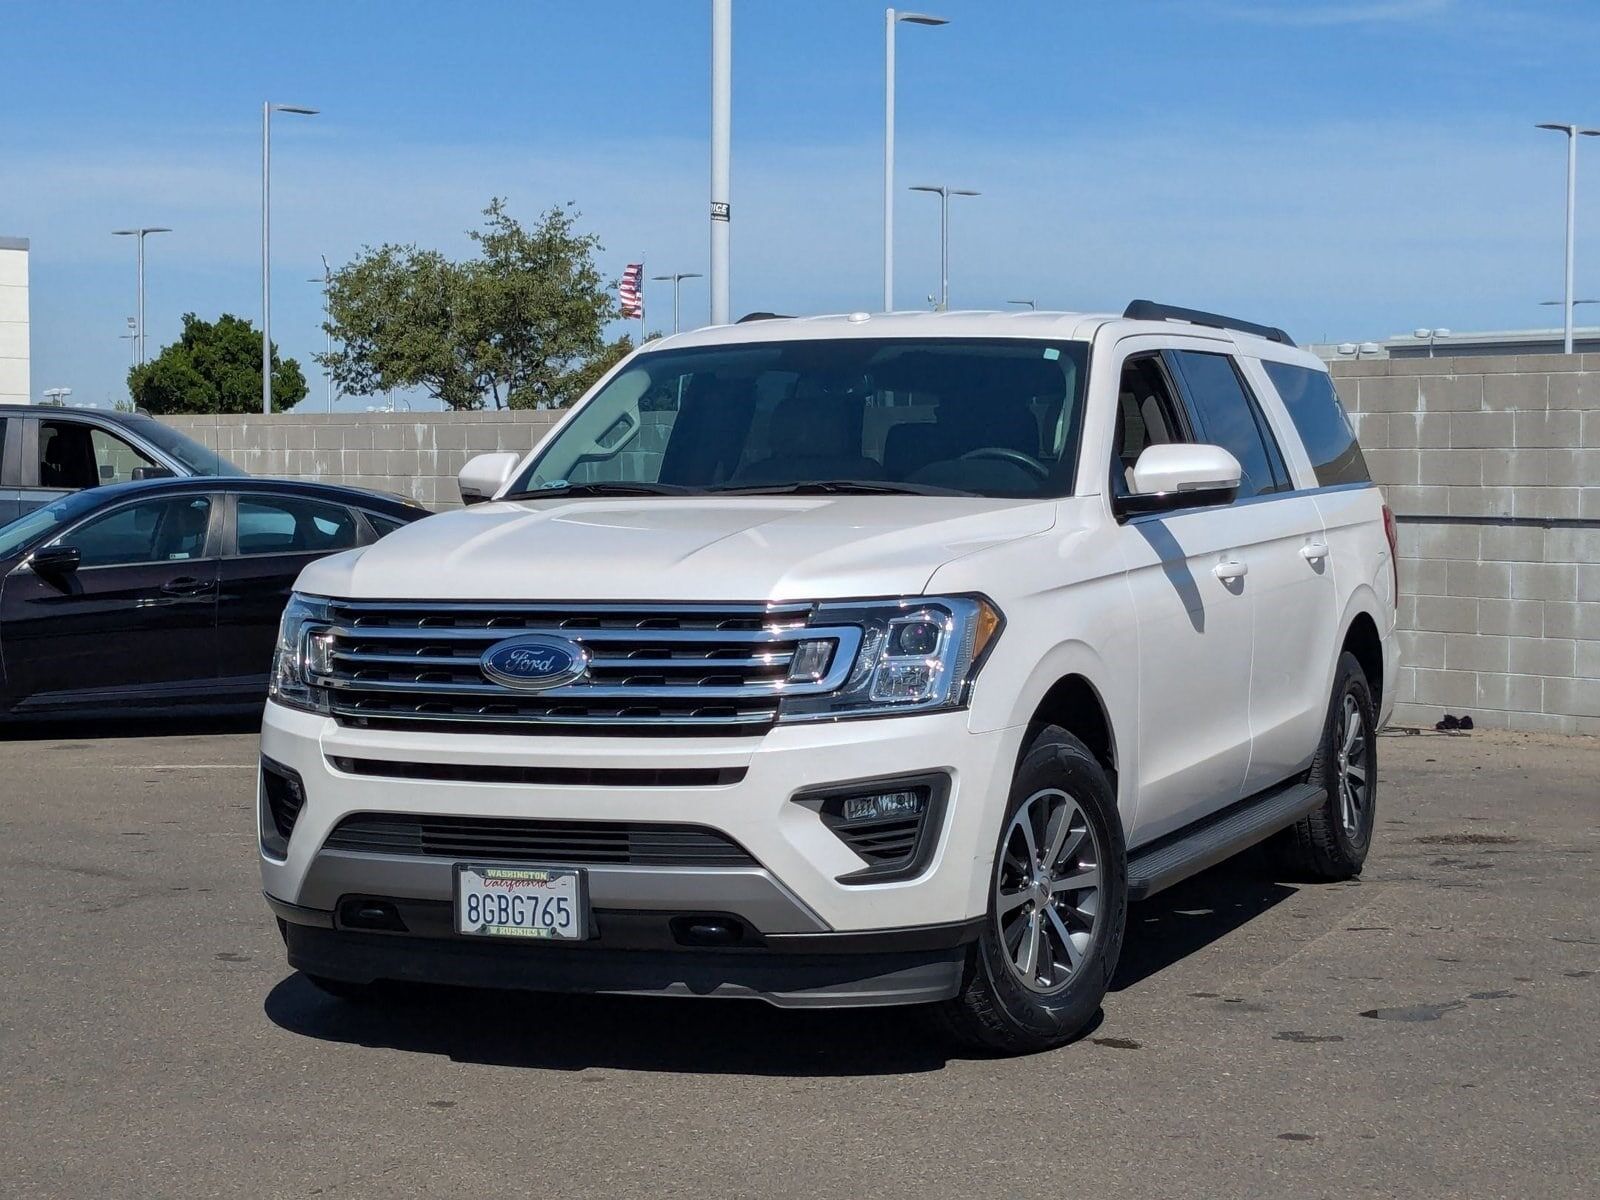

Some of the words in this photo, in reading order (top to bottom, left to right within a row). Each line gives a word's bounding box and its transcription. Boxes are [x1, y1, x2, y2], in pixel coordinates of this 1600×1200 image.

[505, 649, 556, 672] Ford
[487, 869, 548, 880] WASHINGTON
[468, 893, 570, 927] 8GBG765
